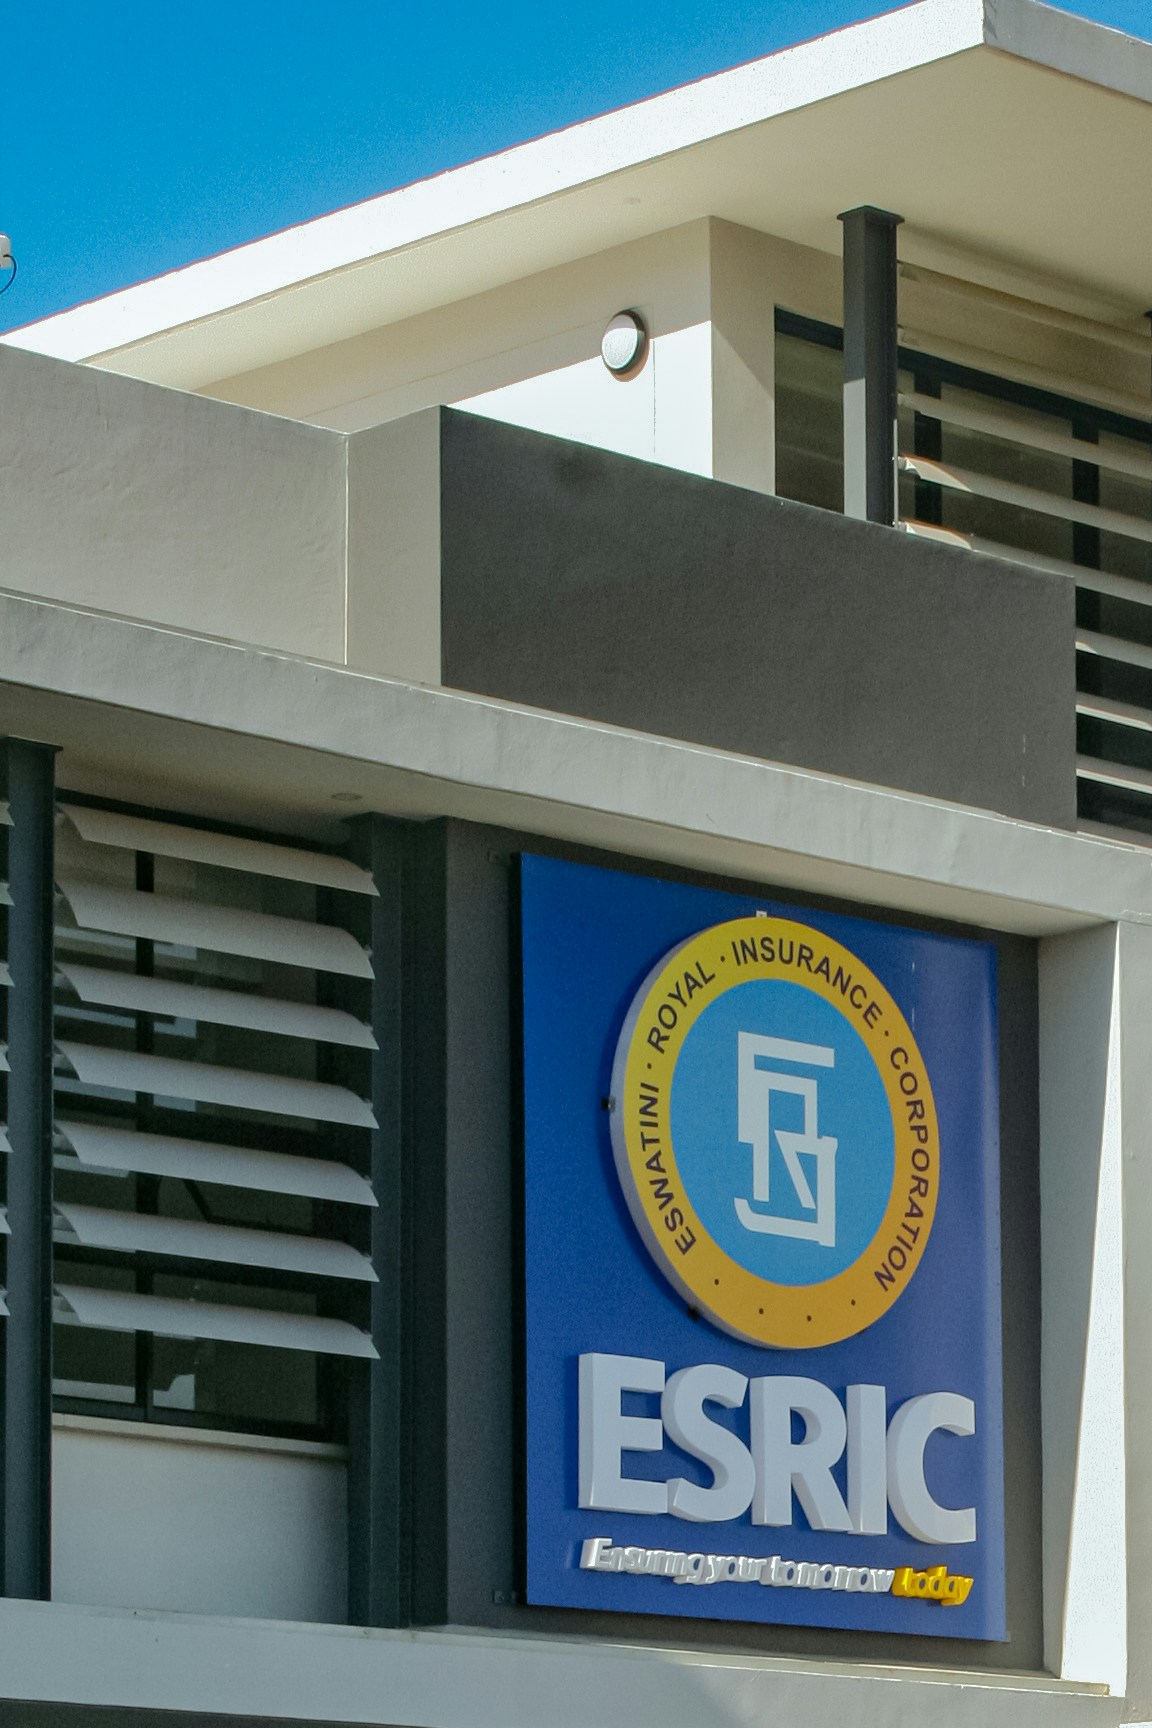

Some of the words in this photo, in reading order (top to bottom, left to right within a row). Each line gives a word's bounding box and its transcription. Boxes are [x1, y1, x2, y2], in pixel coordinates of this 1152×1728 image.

[647, 960, 716, 1055] ROYAL
[731, 935, 883, 1030] INSURANCE
[639, 1081, 697, 1256] ESWATINI
[874, 1046, 931, 1293] CORPORATION
[577, 1352, 977, 1545] ESRIC
[580, 1537, 705, 1585] Ensuring
[704, 1554, 768, 1584] your
[760, 1555, 896, 1593] tomorrow
[892, 1565, 974, 1606] today
